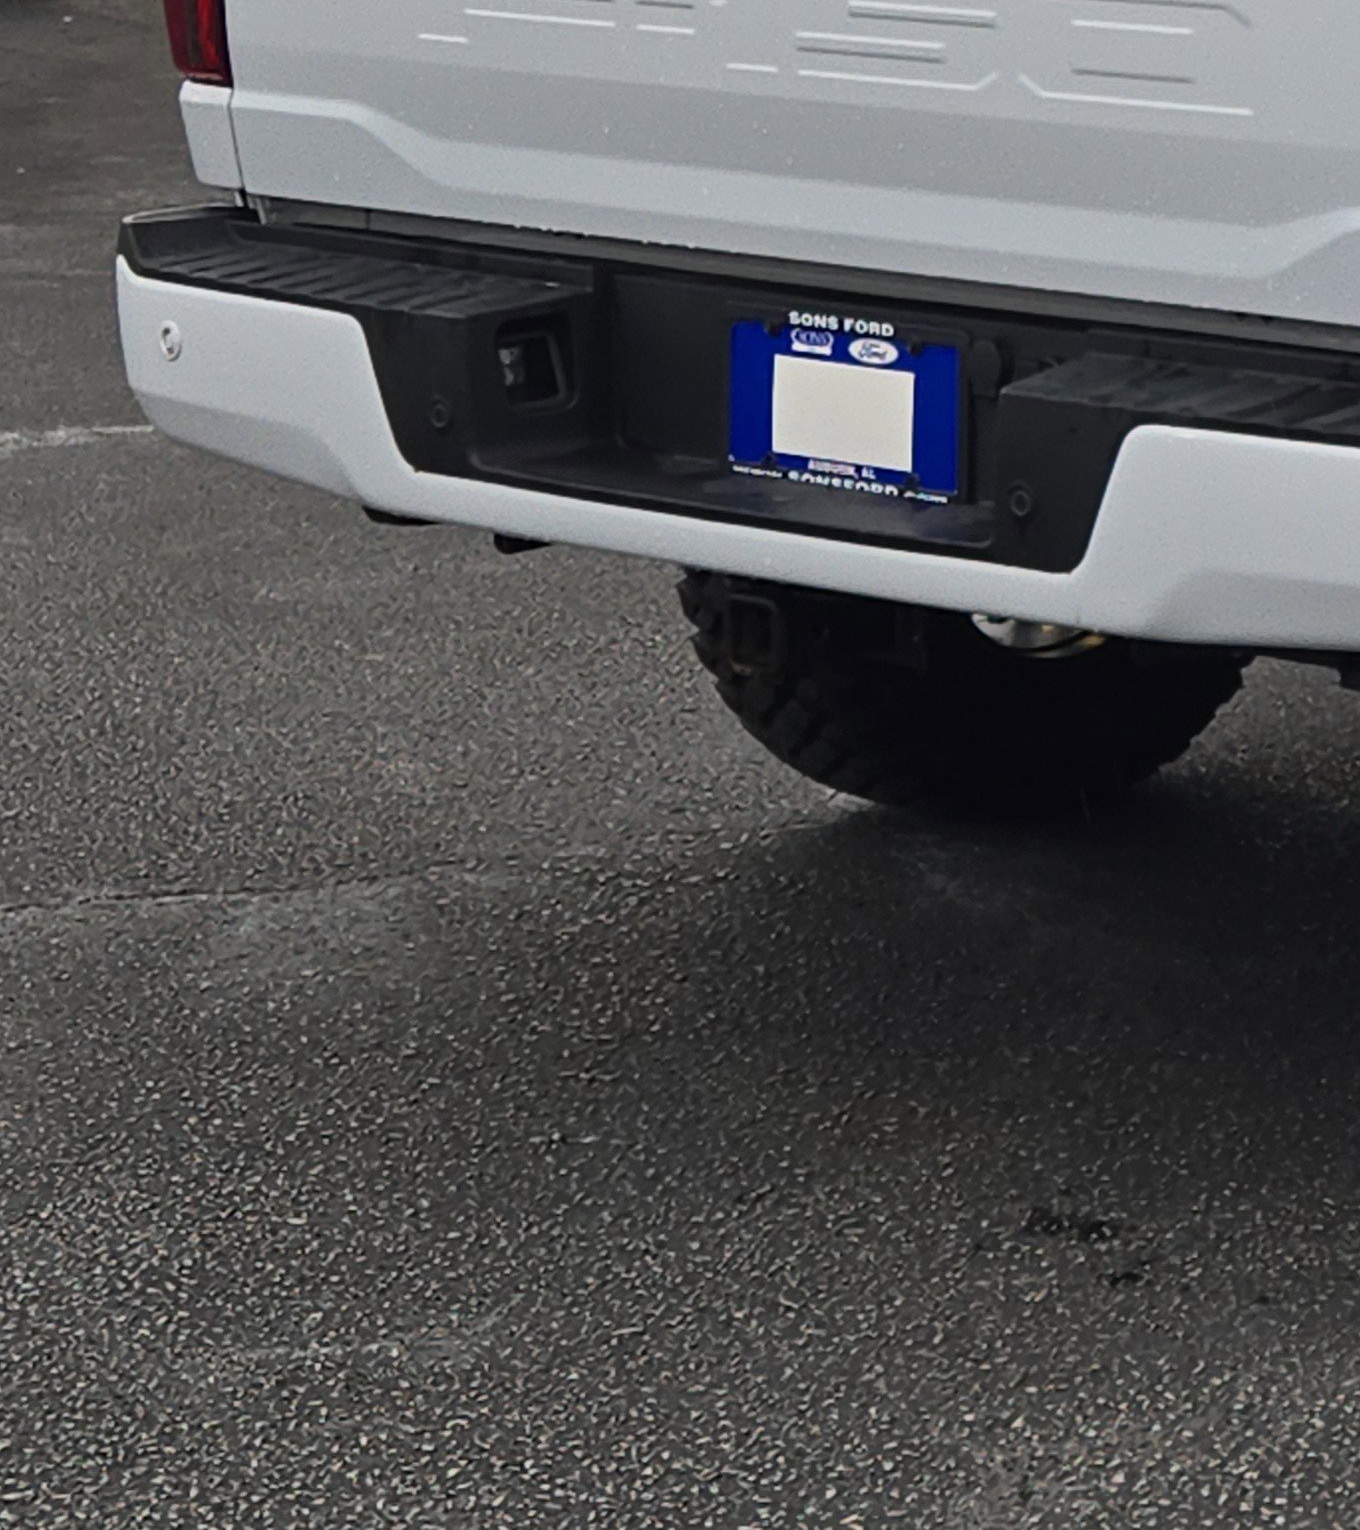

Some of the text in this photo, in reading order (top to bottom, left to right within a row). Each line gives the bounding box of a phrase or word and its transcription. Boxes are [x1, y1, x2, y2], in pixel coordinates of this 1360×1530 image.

[789, 311, 894, 337] SONS FORD
[857, 339, 888, 360] Ford
